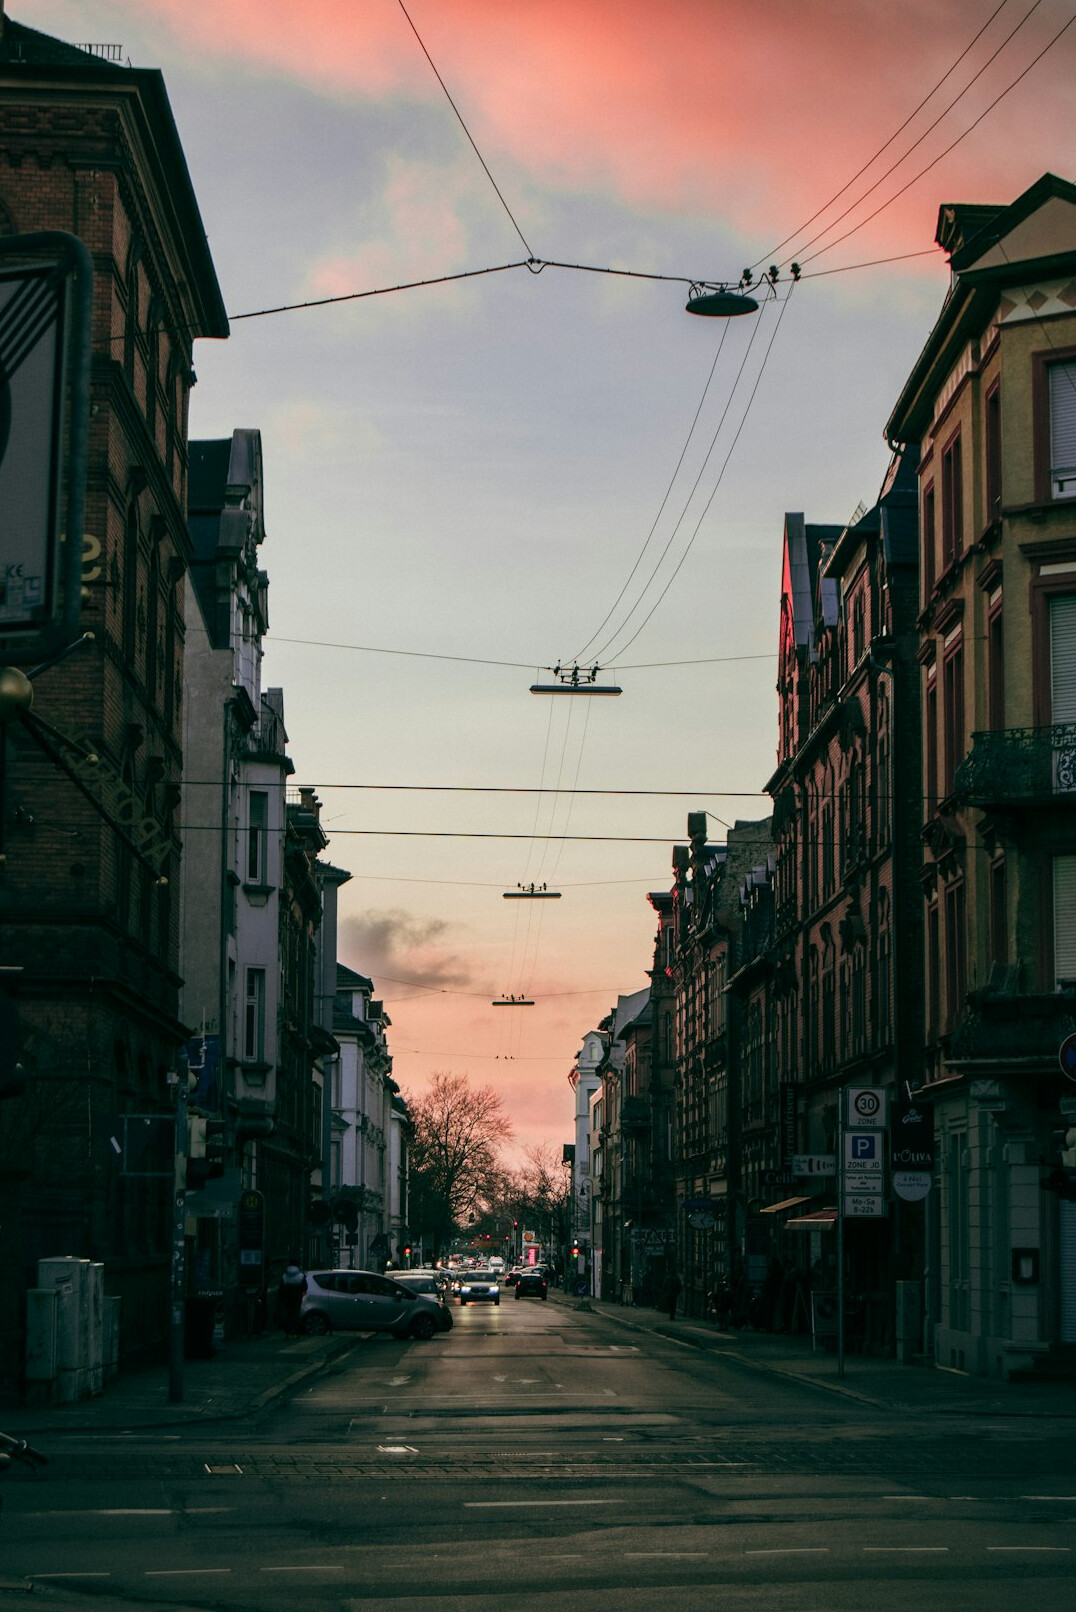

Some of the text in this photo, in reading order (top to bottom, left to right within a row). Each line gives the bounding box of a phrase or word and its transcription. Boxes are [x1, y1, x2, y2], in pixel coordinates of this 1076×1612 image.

[859, 1098, 875, 1110] 30
[857, 1117, 877, 1125] ZONE
[857, 1138, 870, 1157] P
[847, 1161, 867, 1169] ZONE
